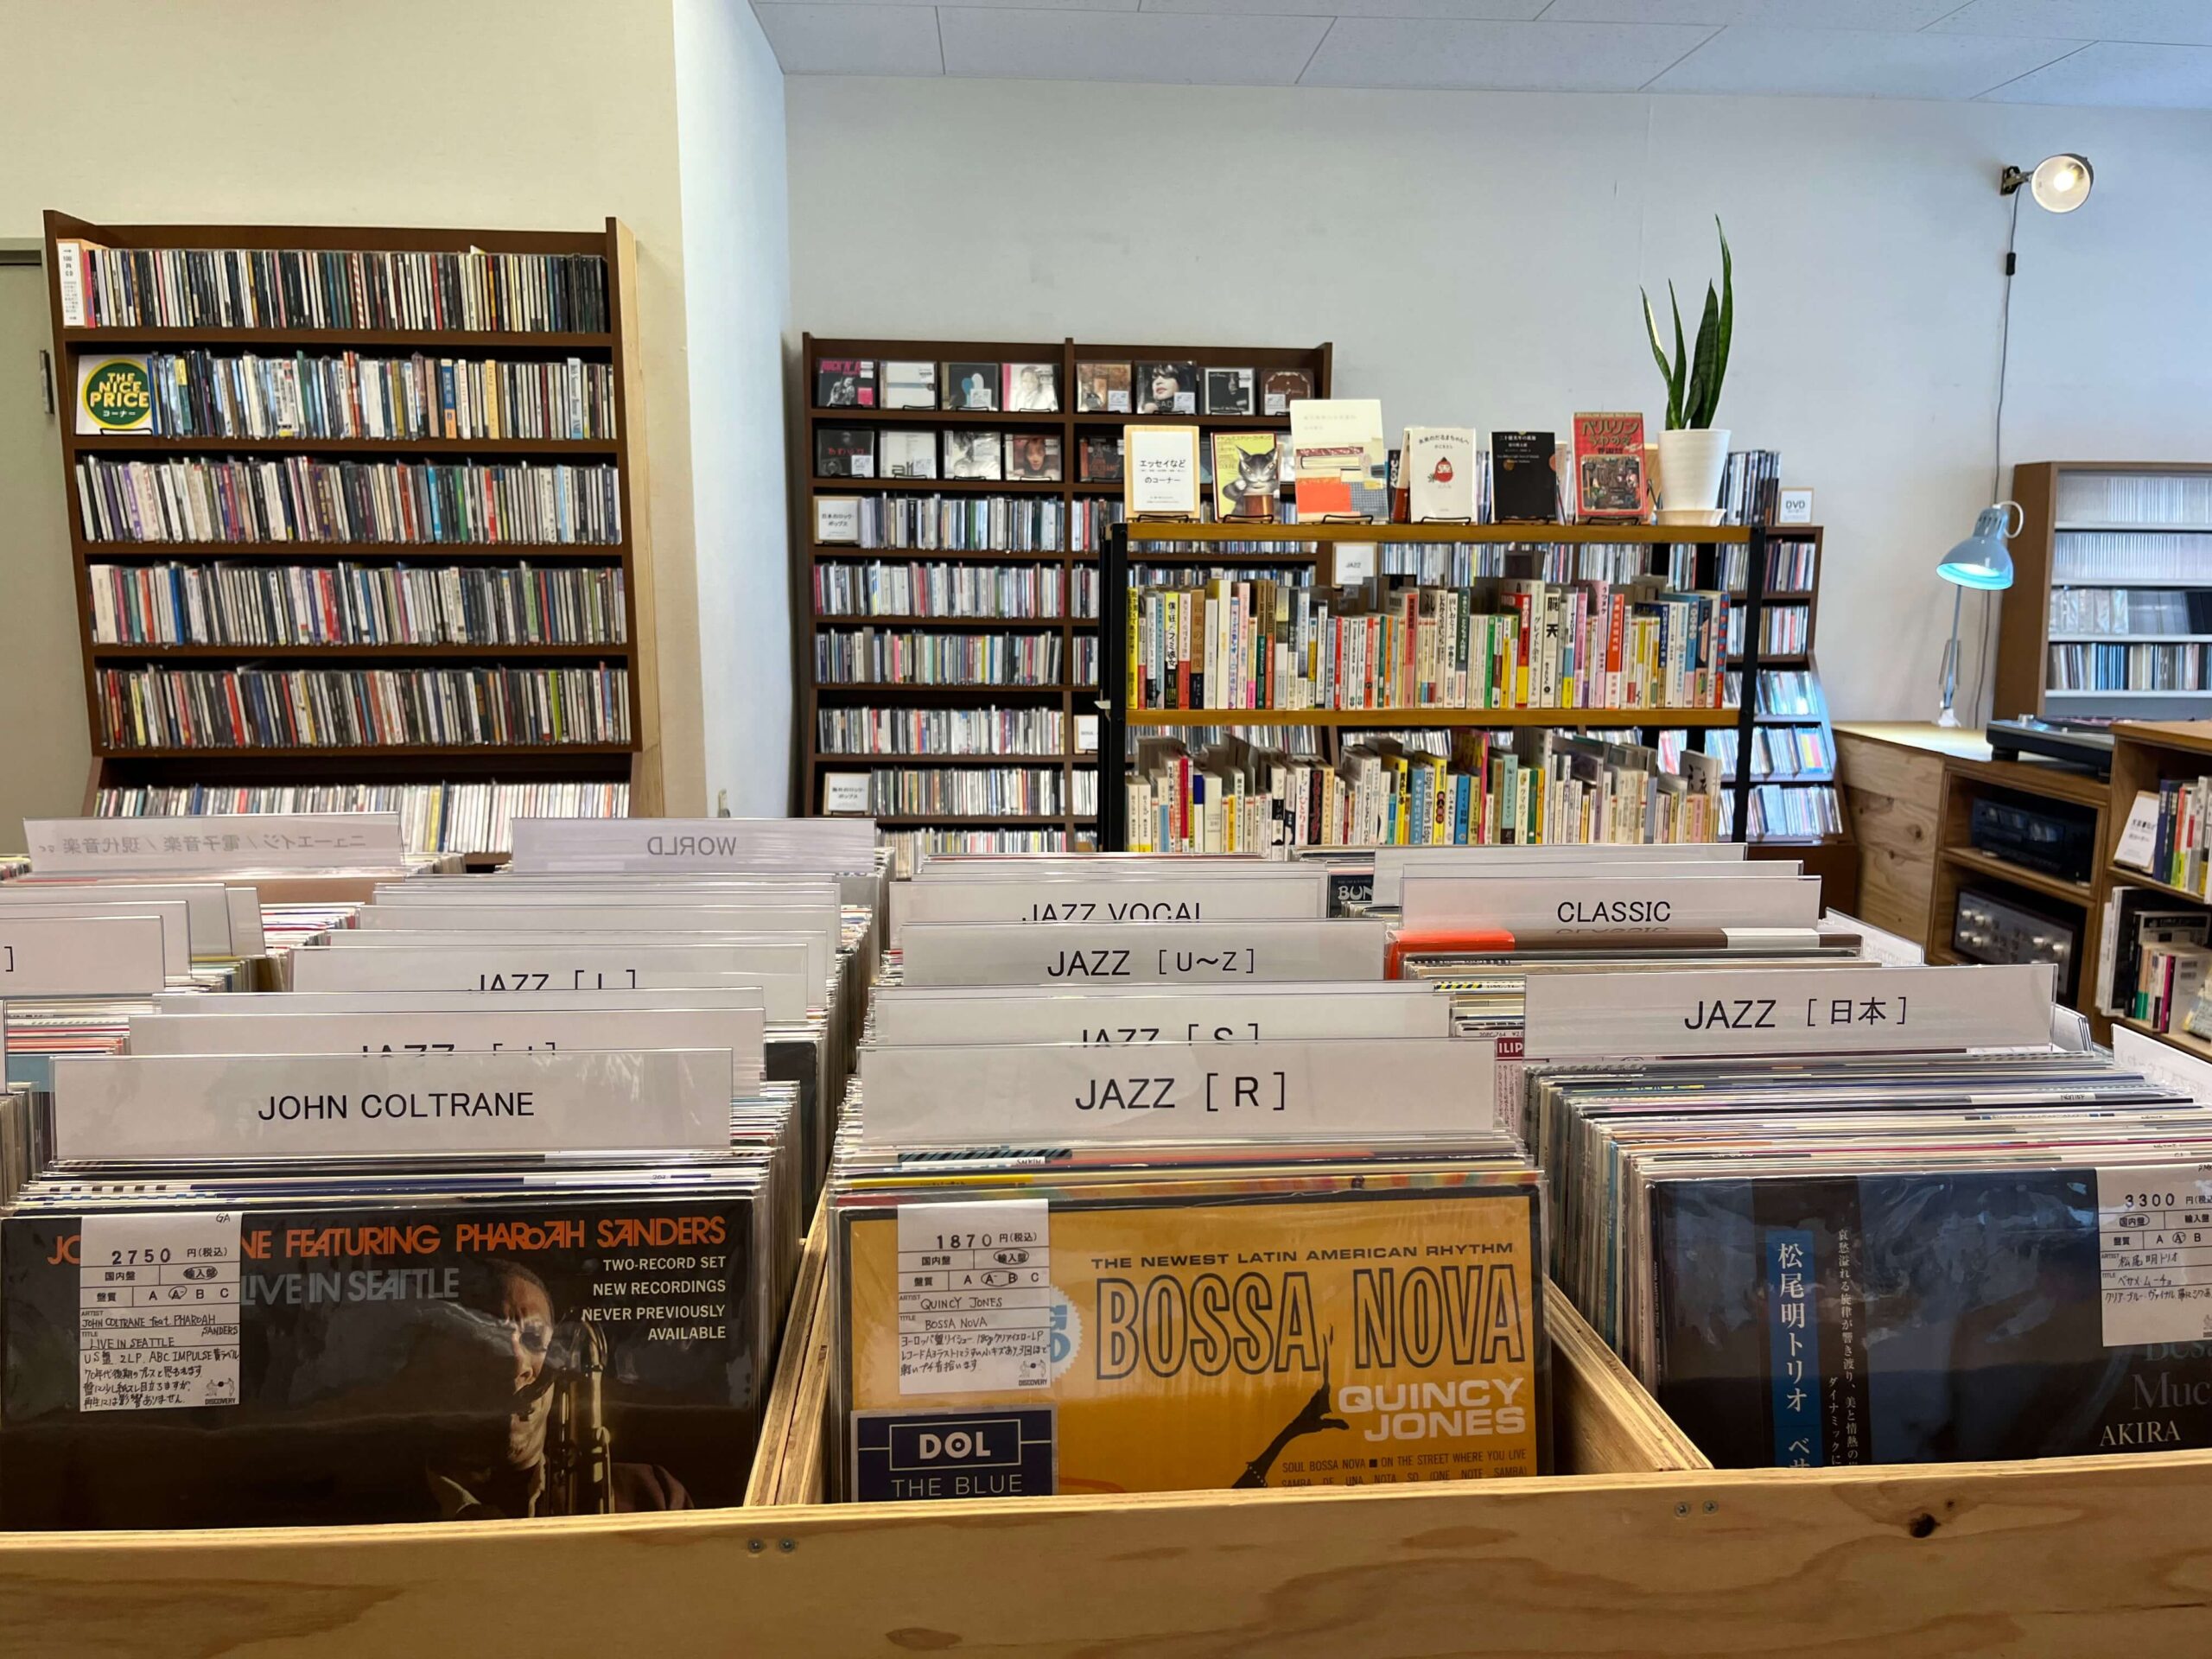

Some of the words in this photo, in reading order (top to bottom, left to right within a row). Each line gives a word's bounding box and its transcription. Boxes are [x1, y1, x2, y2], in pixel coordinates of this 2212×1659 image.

[107, 372, 135, 384] THE
[99, 381, 142, 393] NICE
[90, 392, 149, 408] PRICE
[103, 410, 136, 418] コーナー
[1582, 419, 1639, 436] ベルリン
[1785, 499, 1806, 510] DVD
[1424, 772, 1433, 790] Edge
[1422, 826, 1432, 843] Edge
[1338, 885, 1373, 900] BUN
[1556, 900, 1672, 923] CLASSIC
[1047, 950, 1130, 976] JAZZ
[1684, 1000, 1777, 1030] JAZZ
[1498, 1042, 1523, 1053] ILIP
[1076, 1078, 1175, 1110] JAZZ
[258, 1095, 346, 1121] JOHN
[361, 1092, 535, 1119] COLTRANE
[2125, 1192, 2175, 1208] 3300
[2184, 1213, 2209, 1224] 輸入盤
[286, 1224, 441, 1258] FEATURING
[455, 1219, 585, 1252] PHAROAH
[597, 1216, 727, 1248] SANDERS
[937, 1234, 993, 1249] 1870
[2156, 1235, 2164, 1244] A
[2194, 1232, 2202, 1243] B
[111, 1248, 171, 1265] 2750
[603, 1256, 696, 1272] TWO-RECORD
[701, 1255, 726, 1268] SET
[921, 1255, 950, 1267] 国内盤
[997, 1252, 1027, 1264] 輸入盤
[1091, 1257, 1132, 1269] THE
[1141, 1253, 1229, 1268] NEWEST
[1237, 1250, 1298, 1264] LATIN
[1306, 1246, 1418, 1262] AMERICAN
[1426, 1242, 1514, 1257] RHYTHM
[105, 1270, 136, 1281] 国内盤
[913, 1276, 933, 1287] 盤質
[963, 1274, 972, 1286] A
[1007, 1273, 1018, 1283] B
[1031, 1272, 1039, 1283] C
[97, 1292, 117, 1302] 盤質
[149, 1290, 158, 1300] A
[195, 1288, 204, 1299] B
[219, 1287, 229, 1298] C
[241, 1272, 303, 1306] LIVE
[309, 1270, 340, 1303] IN
[347, 1268, 460, 1302] SEATTLE
[593, 1282, 627, 1296] NEW
[631, 1279, 726, 1294] RECORDINGS
[920, 1296, 962, 1310] QUINCY
[969, 1297, 1003, 1308] JONES
[582, 1307, 632, 1322] NEVER
[636, 1304, 726, 1319] PREVIOUSLY
[81, 1319, 103, 1328] JOHN
[105, 1317, 146, 1327] COLTRANE
[200, 1325, 238, 1337] SANDERS
[925, 1319, 956, 1331] BOSSA
[1096, 1271, 1320, 1381] BOSSA
[1353, 1264, 1525, 1370] NOVA
[1777, 1243, 1808, 1413] 松尾明トリオ
[648, 1325, 726, 1341] AVAILABLE
[90, 1338, 114, 1350] LIVE
[117, 1338, 128, 1349] IN
[130, 1337, 175, 1348] SEATTLE
[149, 1350, 169, 1363] ABC
[1338, 1377, 1525, 1414] QUINCY
[2131, 1371, 2212, 1411] Muc
[1364, 1406, 1526, 1442] JONES
[2099, 1420, 2182, 1447] AKIRA
[918, 1431, 991, 1459] DOL
[1282, 1461, 1305, 1473] SOUL
[1309, 1459, 1338, 1471] BOSSA
[1342, 1458, 1366, 1470] NOVA
[1381, 1457, 1393, 1467] ON
[1397, 1455, 1414, 1466] THE
[1417, 1452, 1449, 1465] STREET
[1452, 1451, 1484, 1464] WHERE
[1487, 1450, 1504, 1461] YOU
[1509, 1448, 1527, 1460] LIVE
[891, 1478, 942, 1498] THE
[955, 1474, 1022, 1495] BLUE
[1374, 1473, 1396, 1484] NOTA
